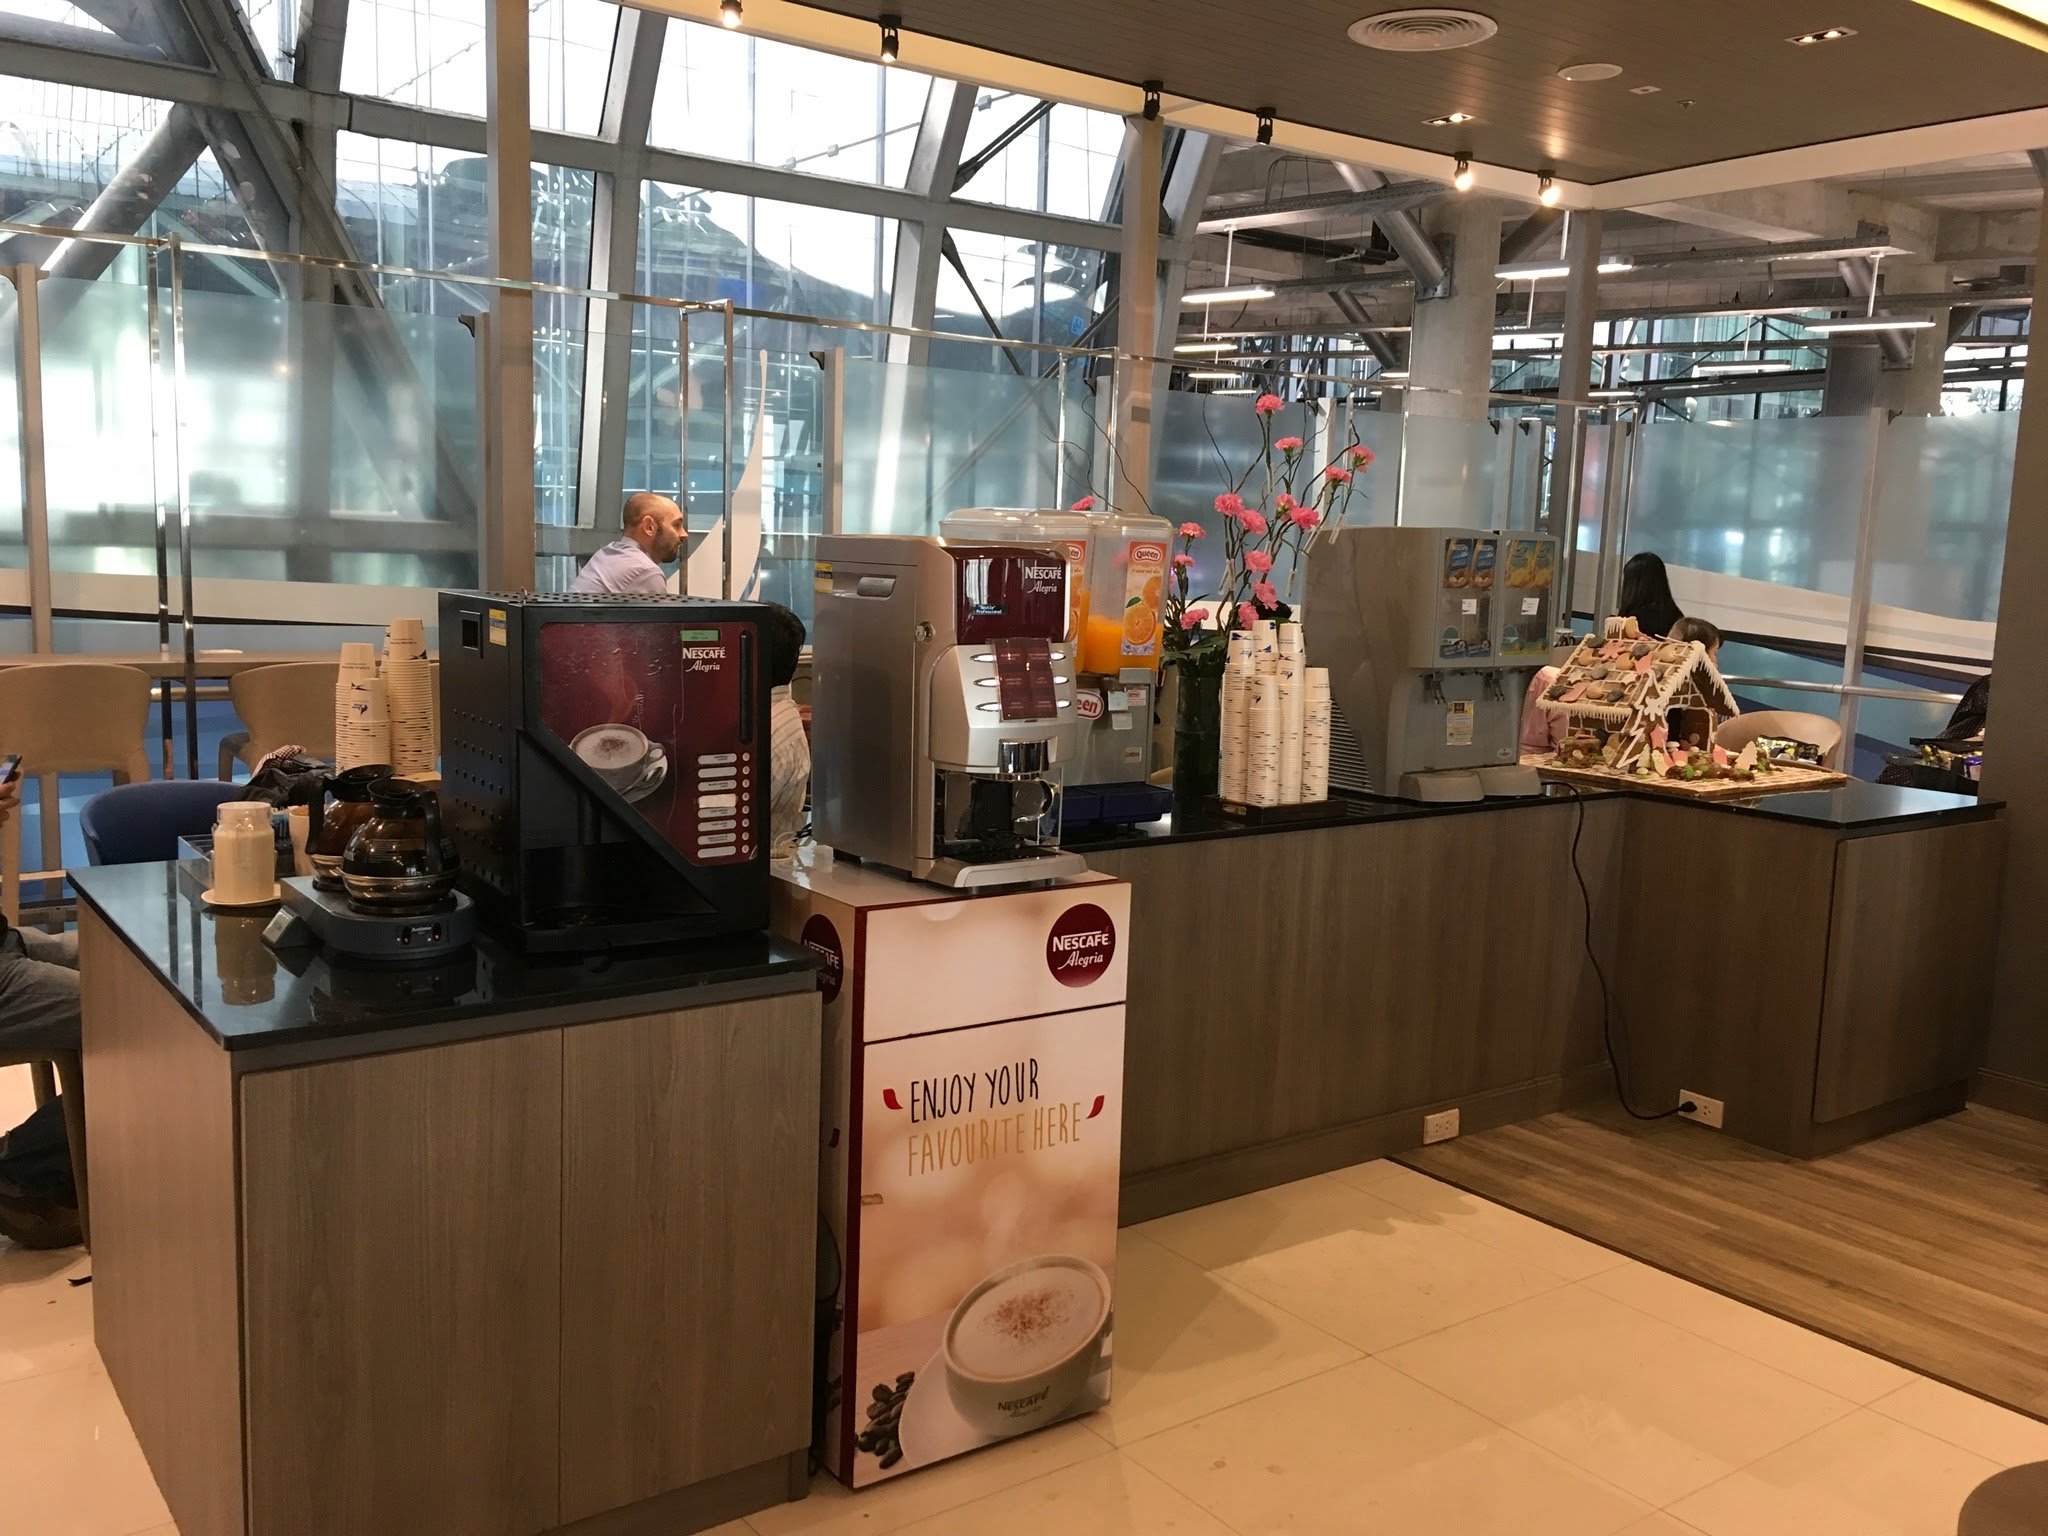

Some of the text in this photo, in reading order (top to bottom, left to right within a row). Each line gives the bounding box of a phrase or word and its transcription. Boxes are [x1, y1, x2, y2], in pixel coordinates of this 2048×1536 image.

[1136, 550, 1159, 559] Queen
[1025, 565, 1062, 579] NESCAFÉ
[1027, 581, 1058, 594] Alegria
[683, 646, 726, 659] NESCAFÉ
[685, 660, 720, 672] Alegria
[1057, 951, 1103, 970] Alegria
[911, 1058, 1039, 1123] ENJOY YOUR
[908, 1102, 1081, 1177] FAVOURITE HERE
